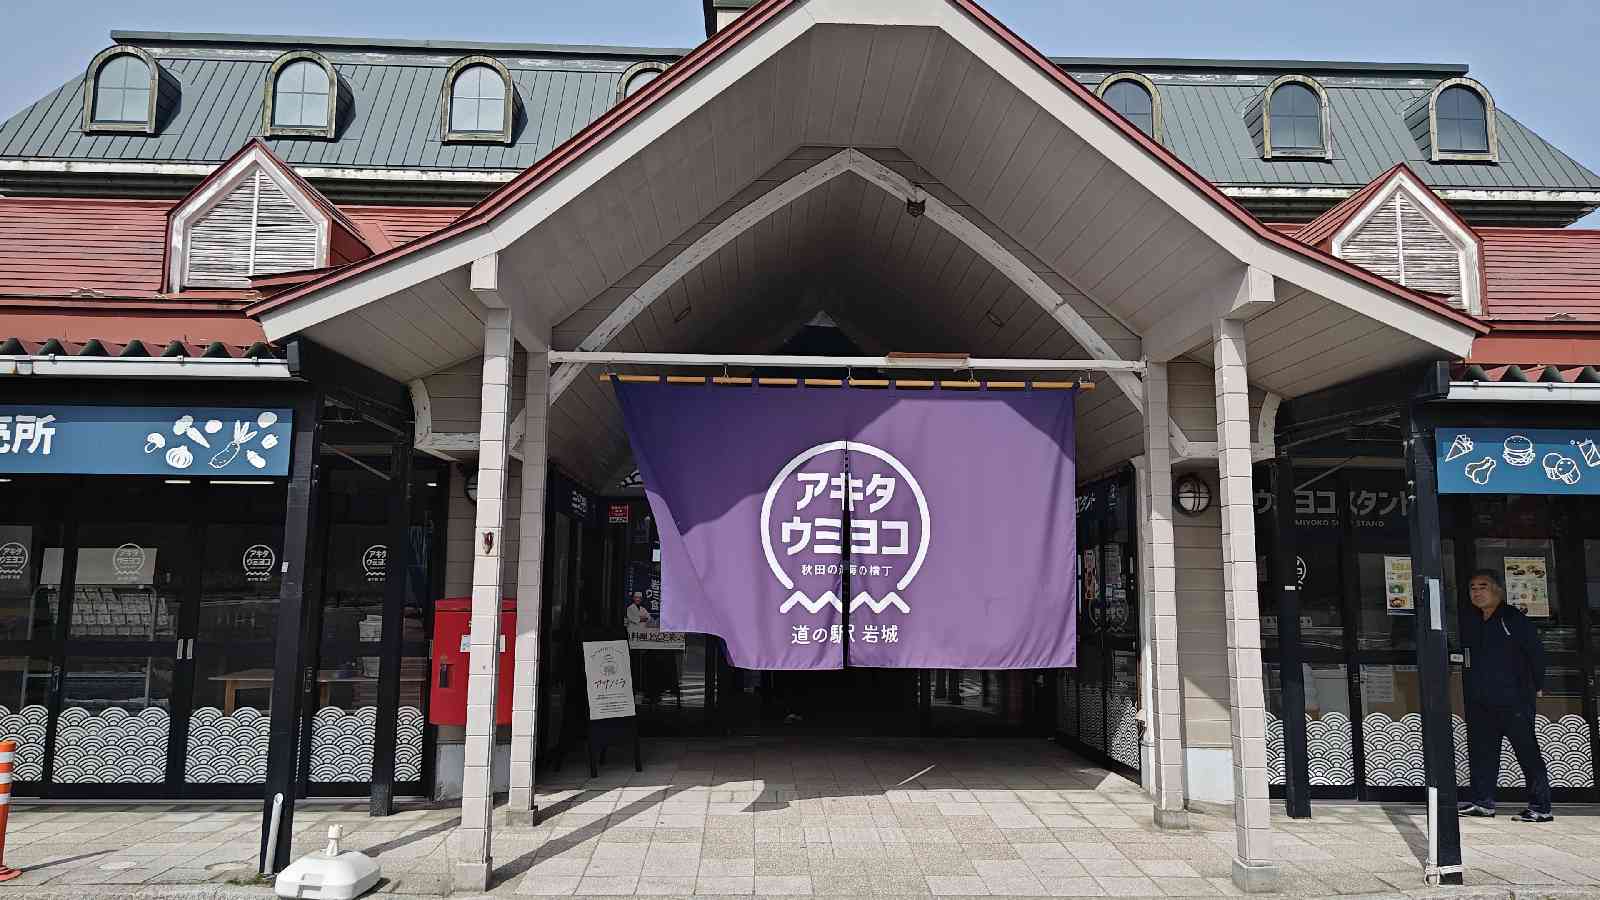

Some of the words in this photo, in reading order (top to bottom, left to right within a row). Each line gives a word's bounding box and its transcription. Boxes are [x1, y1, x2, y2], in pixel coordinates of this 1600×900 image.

[797, 472, 896, 513] アキタ
[781, 516, 909, 556] ウミヨコ
